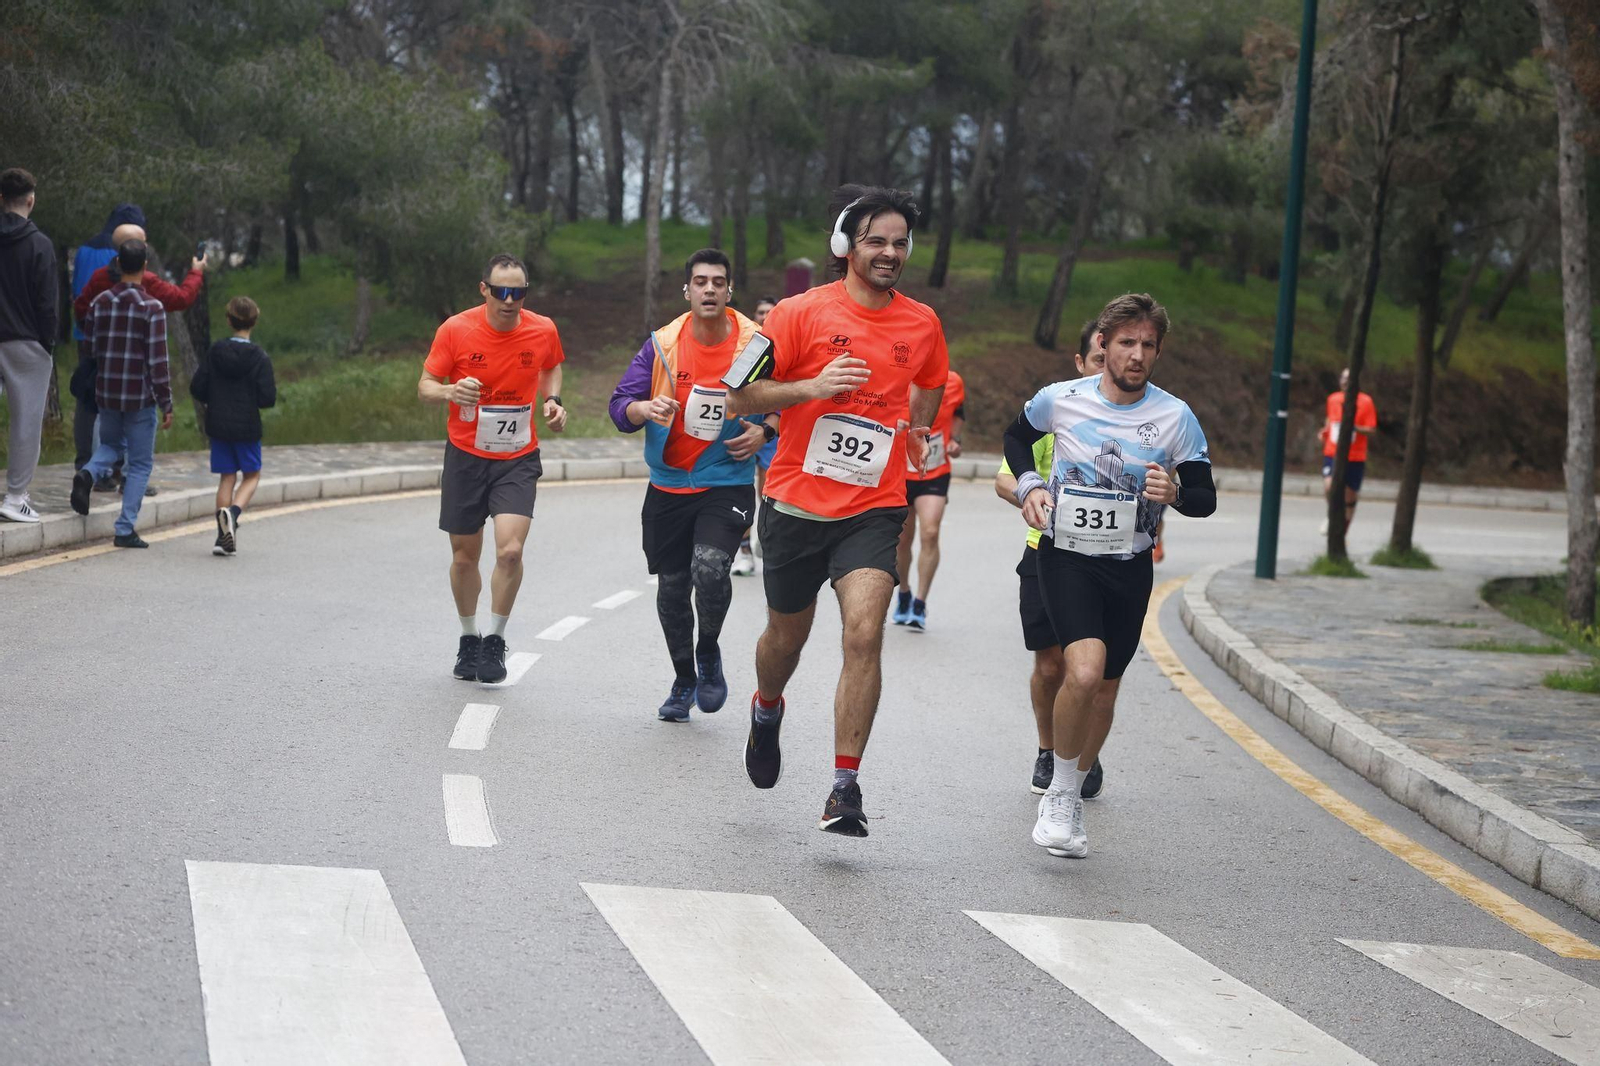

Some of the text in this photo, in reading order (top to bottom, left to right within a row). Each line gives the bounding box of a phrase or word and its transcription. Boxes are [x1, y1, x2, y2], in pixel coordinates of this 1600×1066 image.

[699, 403, 723, 421] 25
[497, 420, 517, 435] 74
[827, 432, 874, 462] 392
[1073, 507, 1119, 530] 331
